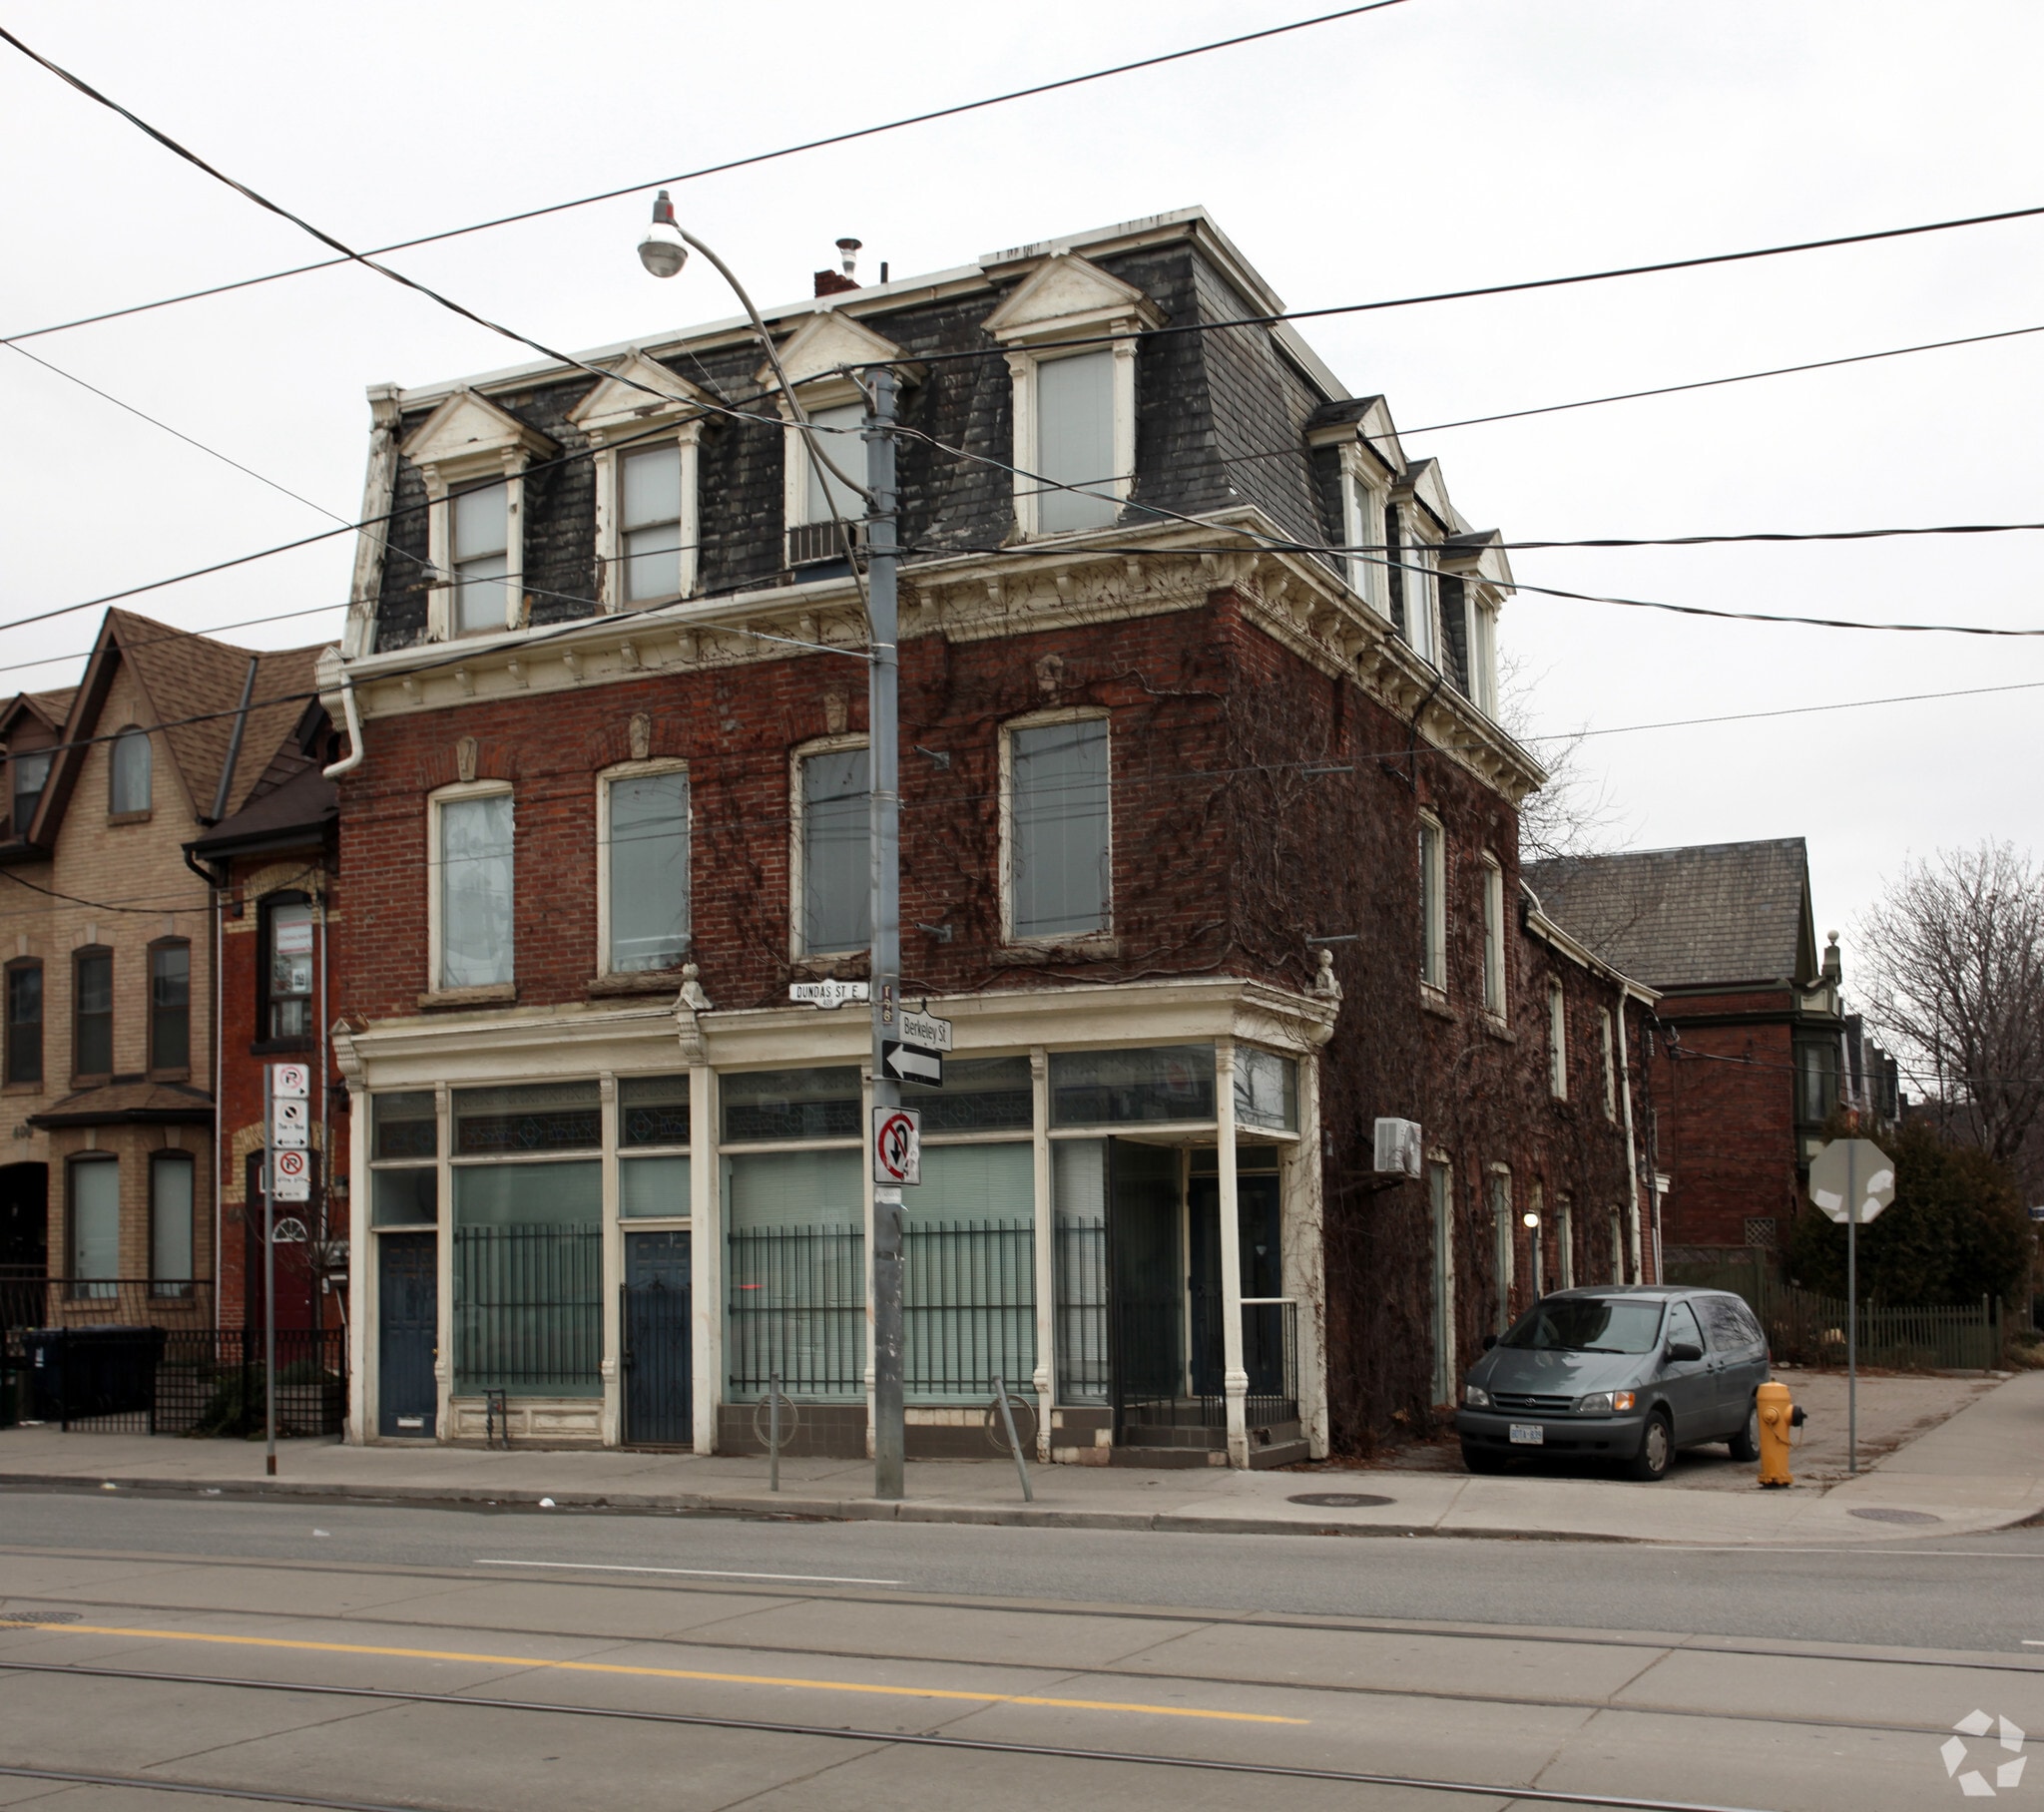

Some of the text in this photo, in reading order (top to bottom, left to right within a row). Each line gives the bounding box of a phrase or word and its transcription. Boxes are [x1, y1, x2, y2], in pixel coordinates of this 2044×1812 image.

[796, 985, 831, 998] DUNDAS
[904, 1016, 947, 1044] Berkeley St
